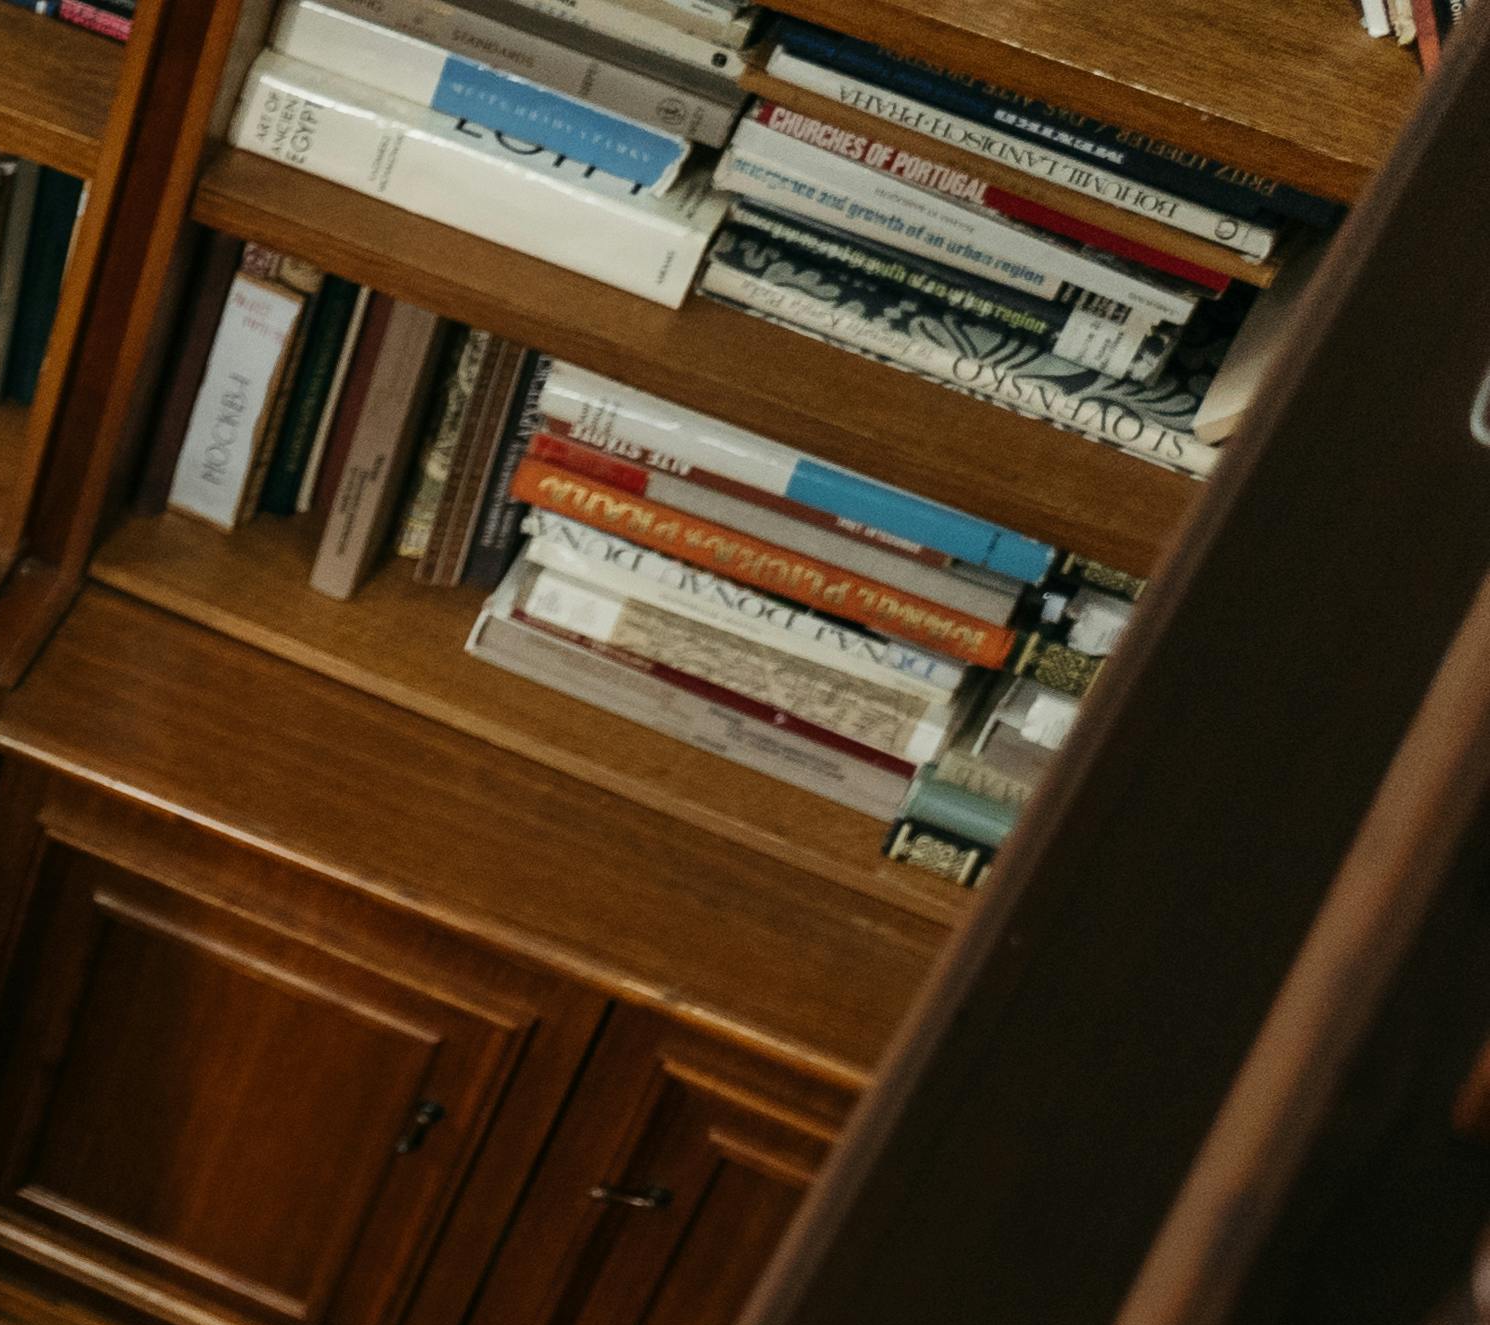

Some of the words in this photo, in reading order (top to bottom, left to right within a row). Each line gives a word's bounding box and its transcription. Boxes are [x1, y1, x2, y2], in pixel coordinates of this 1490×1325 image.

[283, 98, 324, 165] EGYPT
[765, 105, 869, 161] CHURCHES
[863, 139, 896, 171] OF
[888, 149, 990, 206] PORTUGAL
[992, 107, 1125, 165] MEXIKO
[1058, 160, 1180, 221] BOHUMIL
[816, 186, 849, 213] and
[845, 198, 906, 238] growth
[903, 220, 926, 241] of
[922, 229, 946, 249] an
[944, 235, 994, 268] urban
[991, 254, 1047, 289] region
[990, 303, 1049, 339] region
[947, 350, 1189, 461] SLOVENSKO
[657, 560, 799, 632] DONAU
